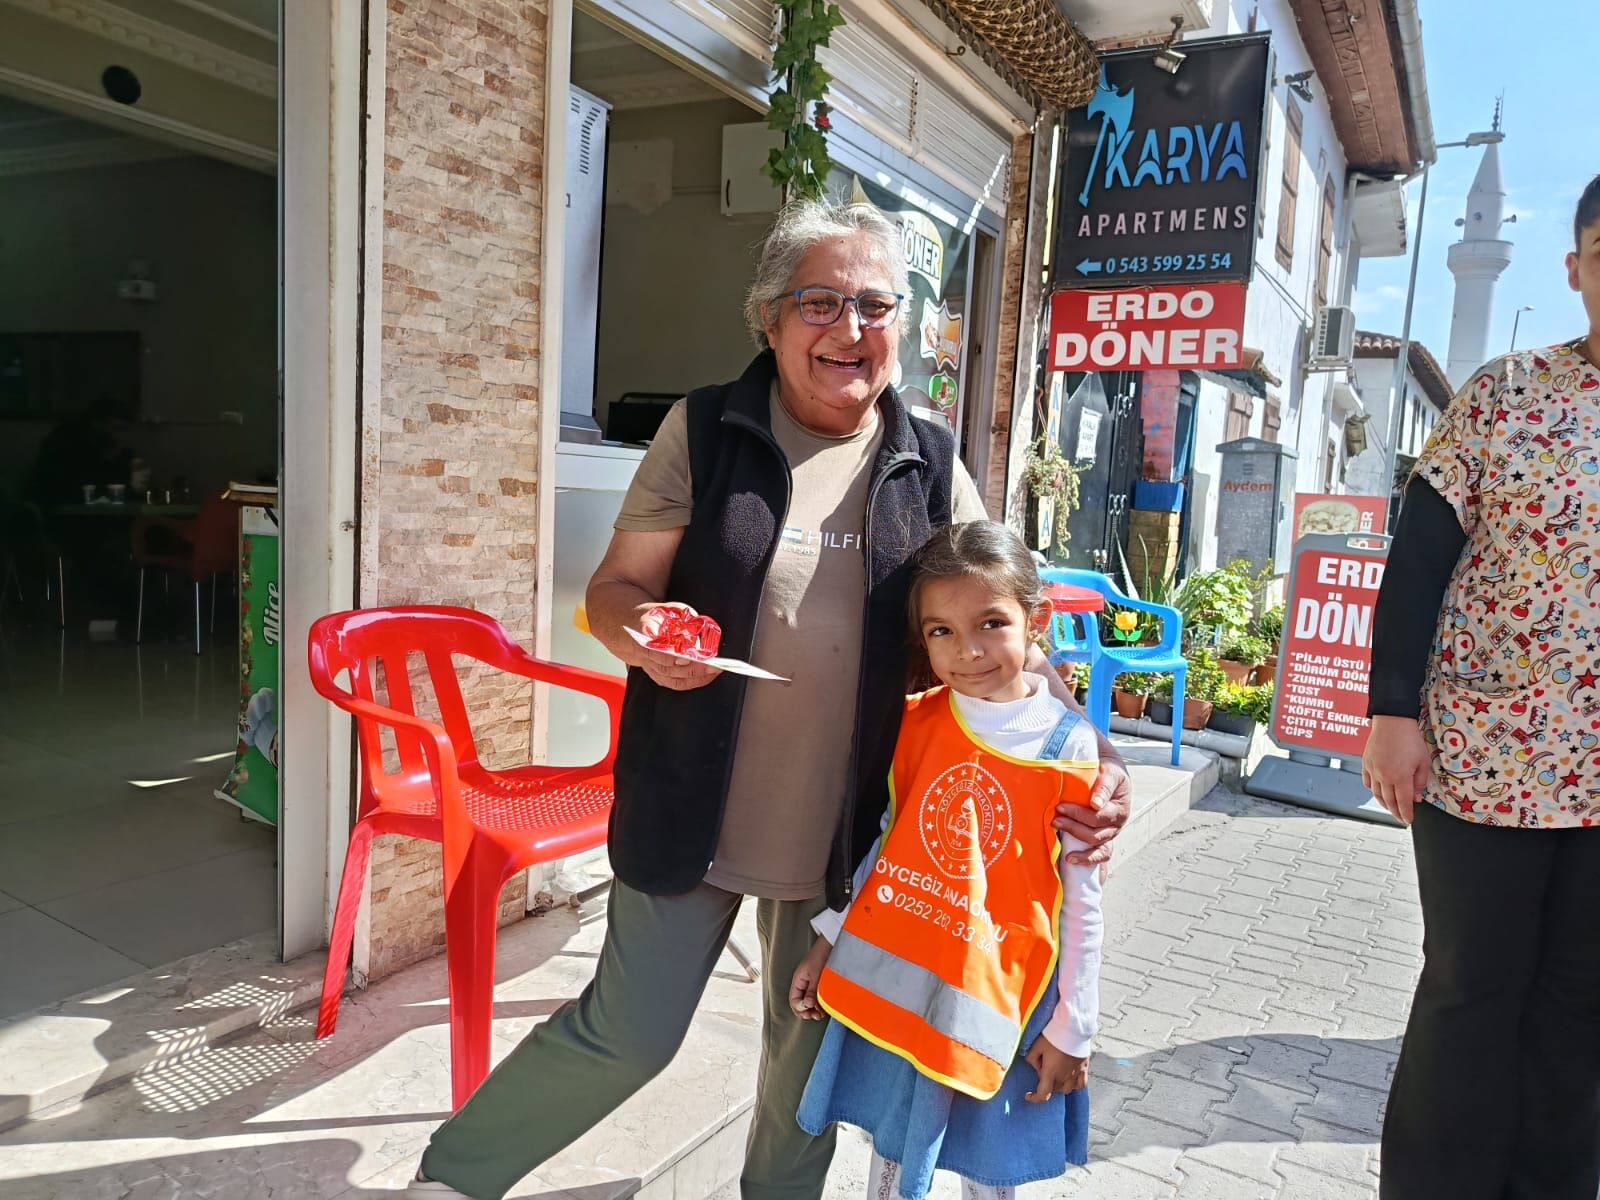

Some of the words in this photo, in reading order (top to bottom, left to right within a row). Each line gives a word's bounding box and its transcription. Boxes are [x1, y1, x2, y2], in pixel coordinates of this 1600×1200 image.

[1105, 121, 1247, 189] KARYA
[1077, 205, 1248, 237] APARTMENS
[1106, 258, 1116, 273] 0
[1119, 256, 1148, 273] 543
[1152, 255, 1182, 272] 599
[1185, 253, 1207, 271] 25
[1210, 252, 1232, 269] 54
[1087, 291, 1215, 322] ERDO
[1054, 321, 1239, 367] DÖNER
[1294, 592, 1373, 649] DÖN
[1294, 662, 1339, 677] DÜRÜM
[1295, 652, 1330, 665] PİLAV
[1332, 656, 1364, 670] ÜSTÜ
[1291, 684, 1321, 697] TOST
[1292, 673, 1334, 688] ZURNA
[1289, 694, 1334, 709] KUMRU
[1286, 715, 1317, 728] ÇITIR
[1320, 721, 1360, 736] TAVUK
[1288, 704, 1325, 719] KÖFTE
[1327, 711, 1371, 727] EKMEK
[1284, 726, 1314, 739] CİPS
[894, 892, 933, 920] 0252
[951, 921, 976, 942] 33
